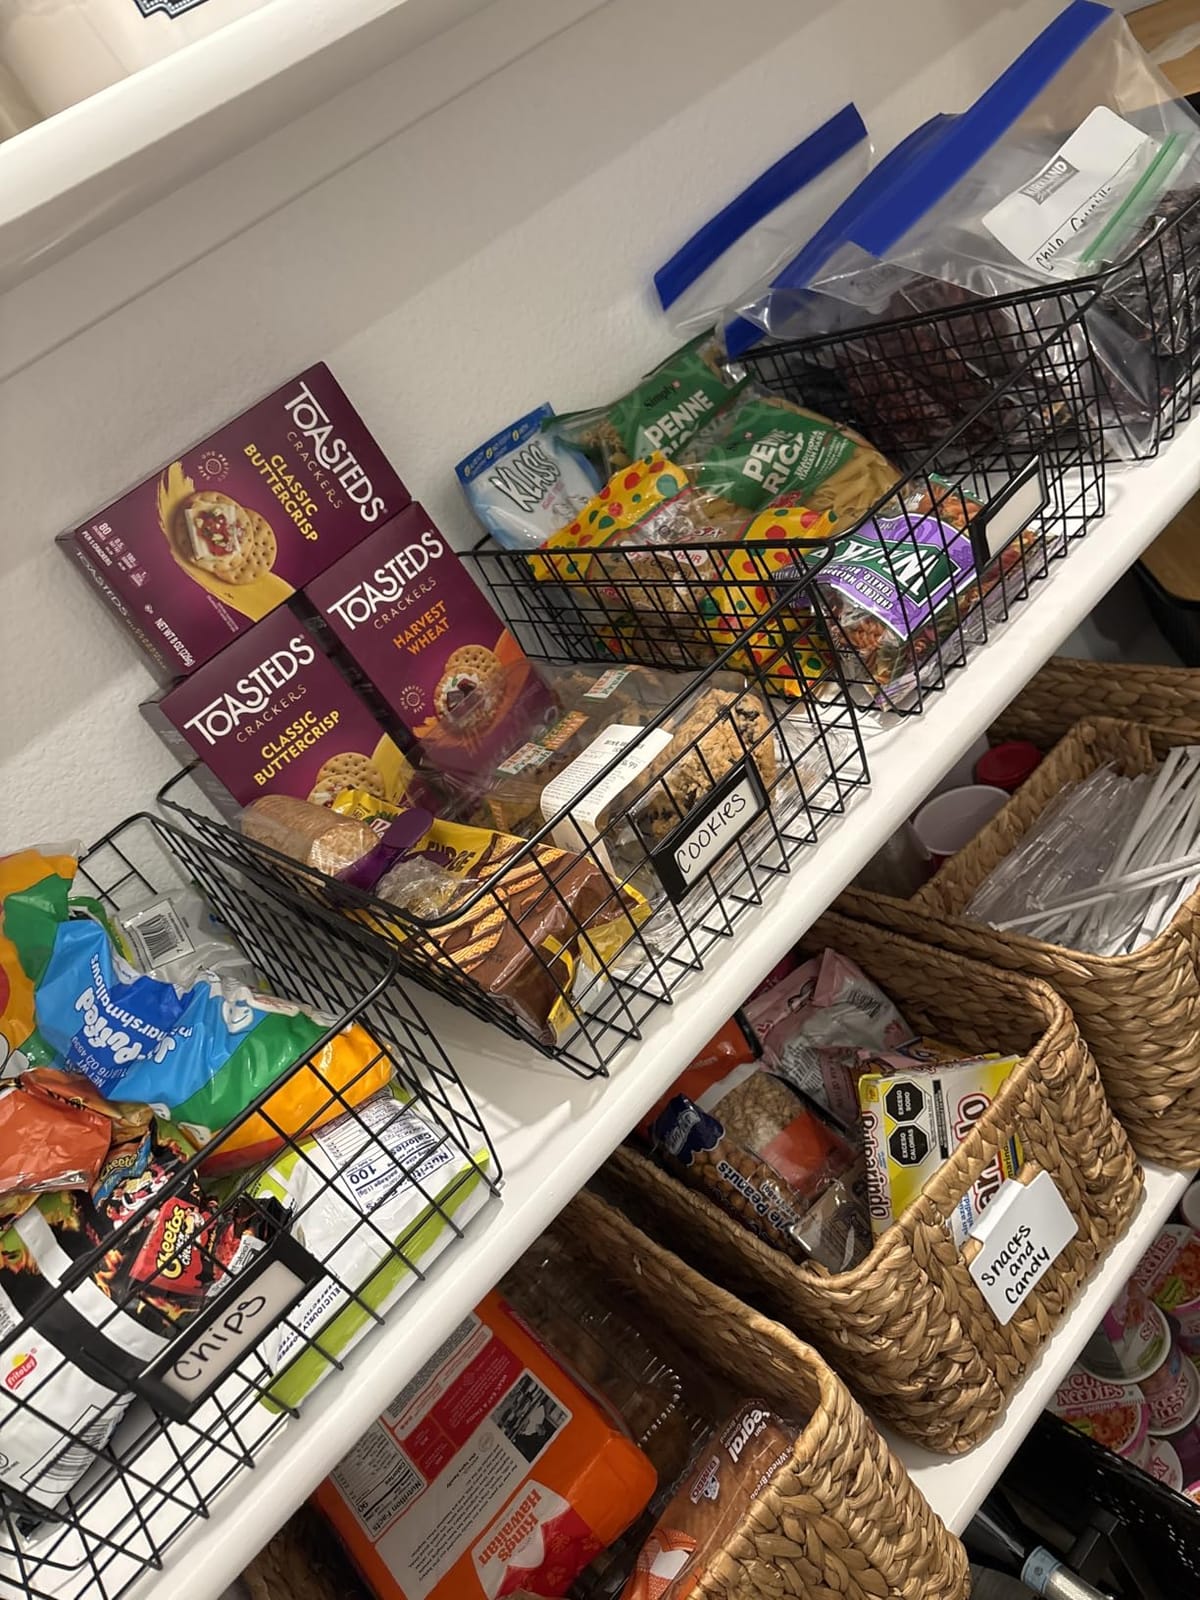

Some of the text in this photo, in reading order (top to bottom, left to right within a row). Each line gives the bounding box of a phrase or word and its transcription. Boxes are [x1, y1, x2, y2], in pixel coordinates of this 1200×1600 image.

[643, 389, 714, 449] PENNE
[284, 381, 385, 522] TOASTEDS
[287, 431, 343, 510] CRACKERS
[245, 444, 318, 542] BUTTERCRISP
[271, 455, 318, 516] CLASSIC
[489, 444, 561, 513] KLASS
[326, 531, 444, 631] TOASTEDS
[373, 576, 437, 630] CRACKERS
[855, 582, 893, 610] ENRICHED
[392, 600, 448, 648] HARVEST
[406, 619, 451, 657] WHEAT
[184, 637, 315, 746] TOASTEDS
[236, 683, 307, 743] CRACKERS
[253, 710, 341, 787] BUTTERCRISP
[261, 710, 317, 760] CLASSIC
[427, 840, 476, 873] FUDGE
[896, 1089, 904, 1116] EXCESO
[904, 1091, 912, 1113] SODIO
[900, 1131, 908, 1159] EXCESO
[350, 1164, 377, 1186] 100
[717, 1160, 768, 1216] Peanuts
[157, 1205, 185, 1280] Cheetos
[1009, 1241, 1035, 1277] and
[1005, 1249, 1050, 1304] Candy
[302, 1287, 342, 1332] ELICIOUSLY
[1057, 1386, 1124, 1408] NOODLES
[754, 1421, 767, 1437] Pan
[767, 1453, 788, 1478] Wheat
[373, 1482, 422, 1531] Nutrition Facts
[478, 1488, 542, 1566] Hawaiian
[500, 1513, 539, 1563] King's
